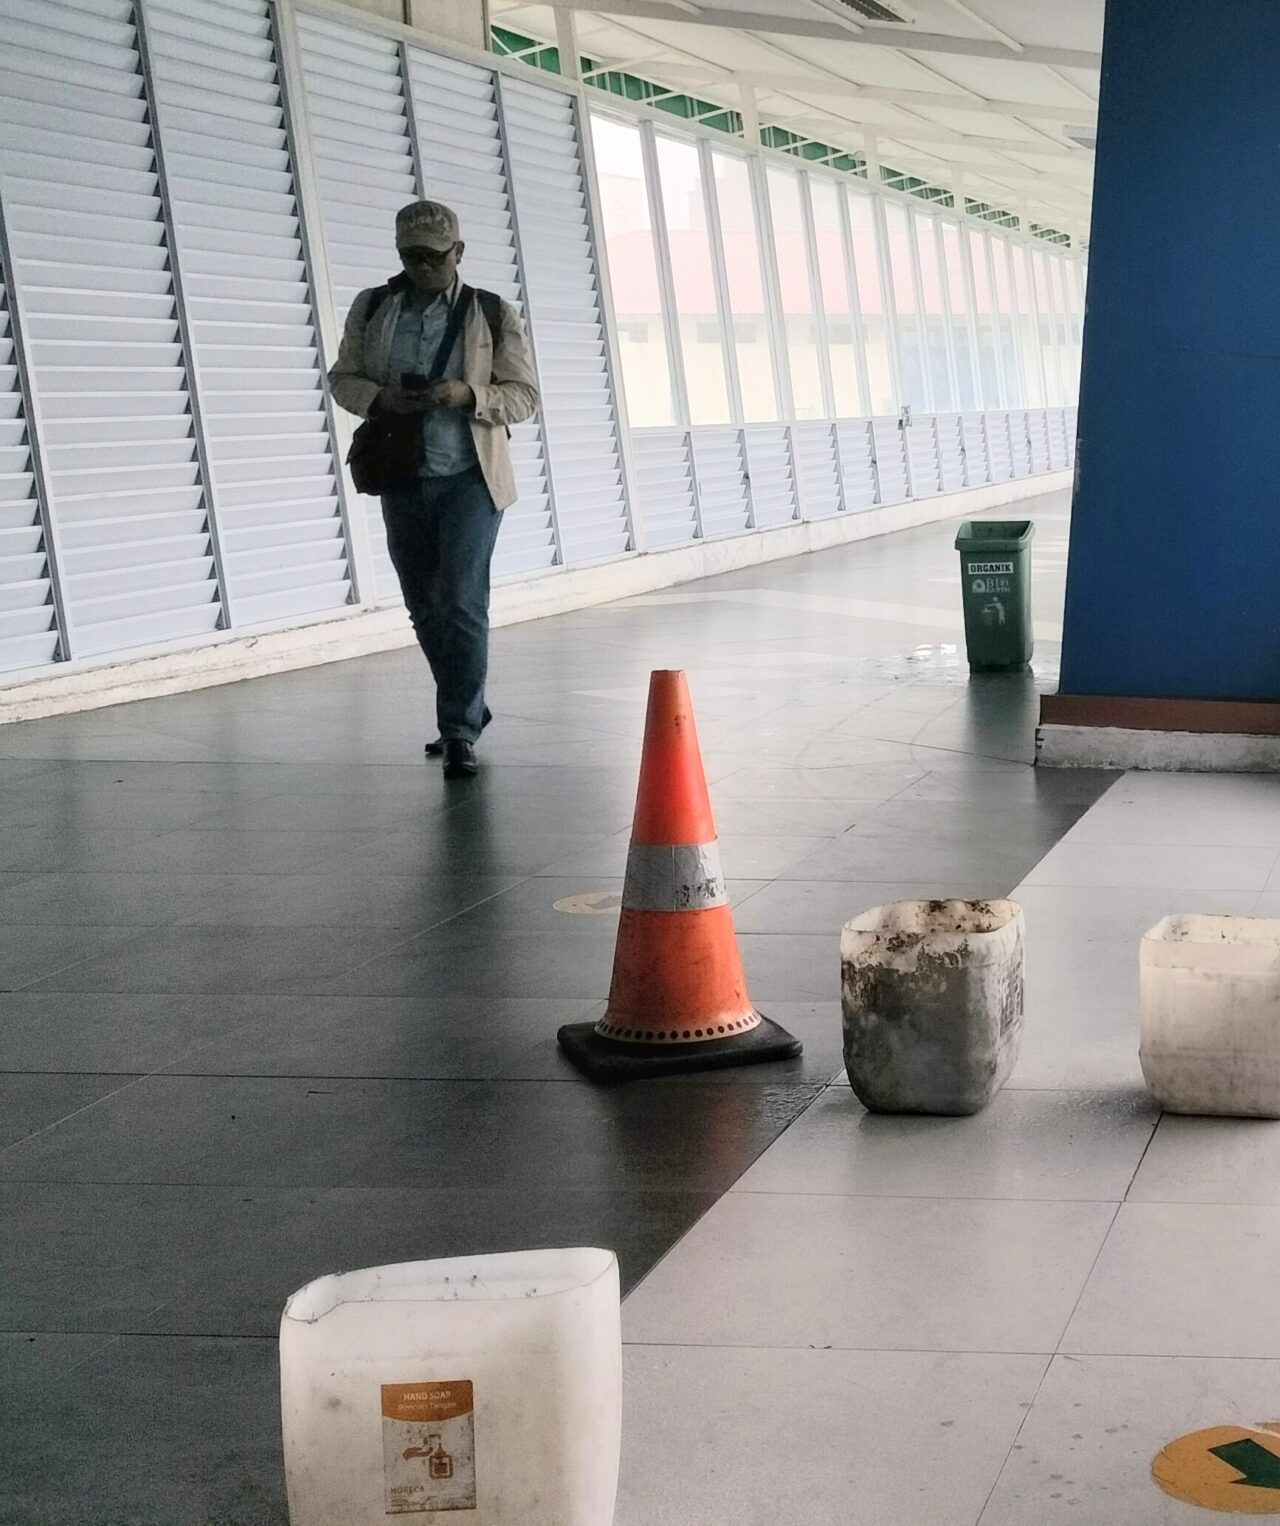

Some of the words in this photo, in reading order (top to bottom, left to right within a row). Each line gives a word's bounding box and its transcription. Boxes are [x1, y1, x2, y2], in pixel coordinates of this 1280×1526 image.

[970, 564, 1011, 572] ORGANIK
[403, 1392, 428, 1401] HAND
[429, 1391, 451, 1400] SOAP
